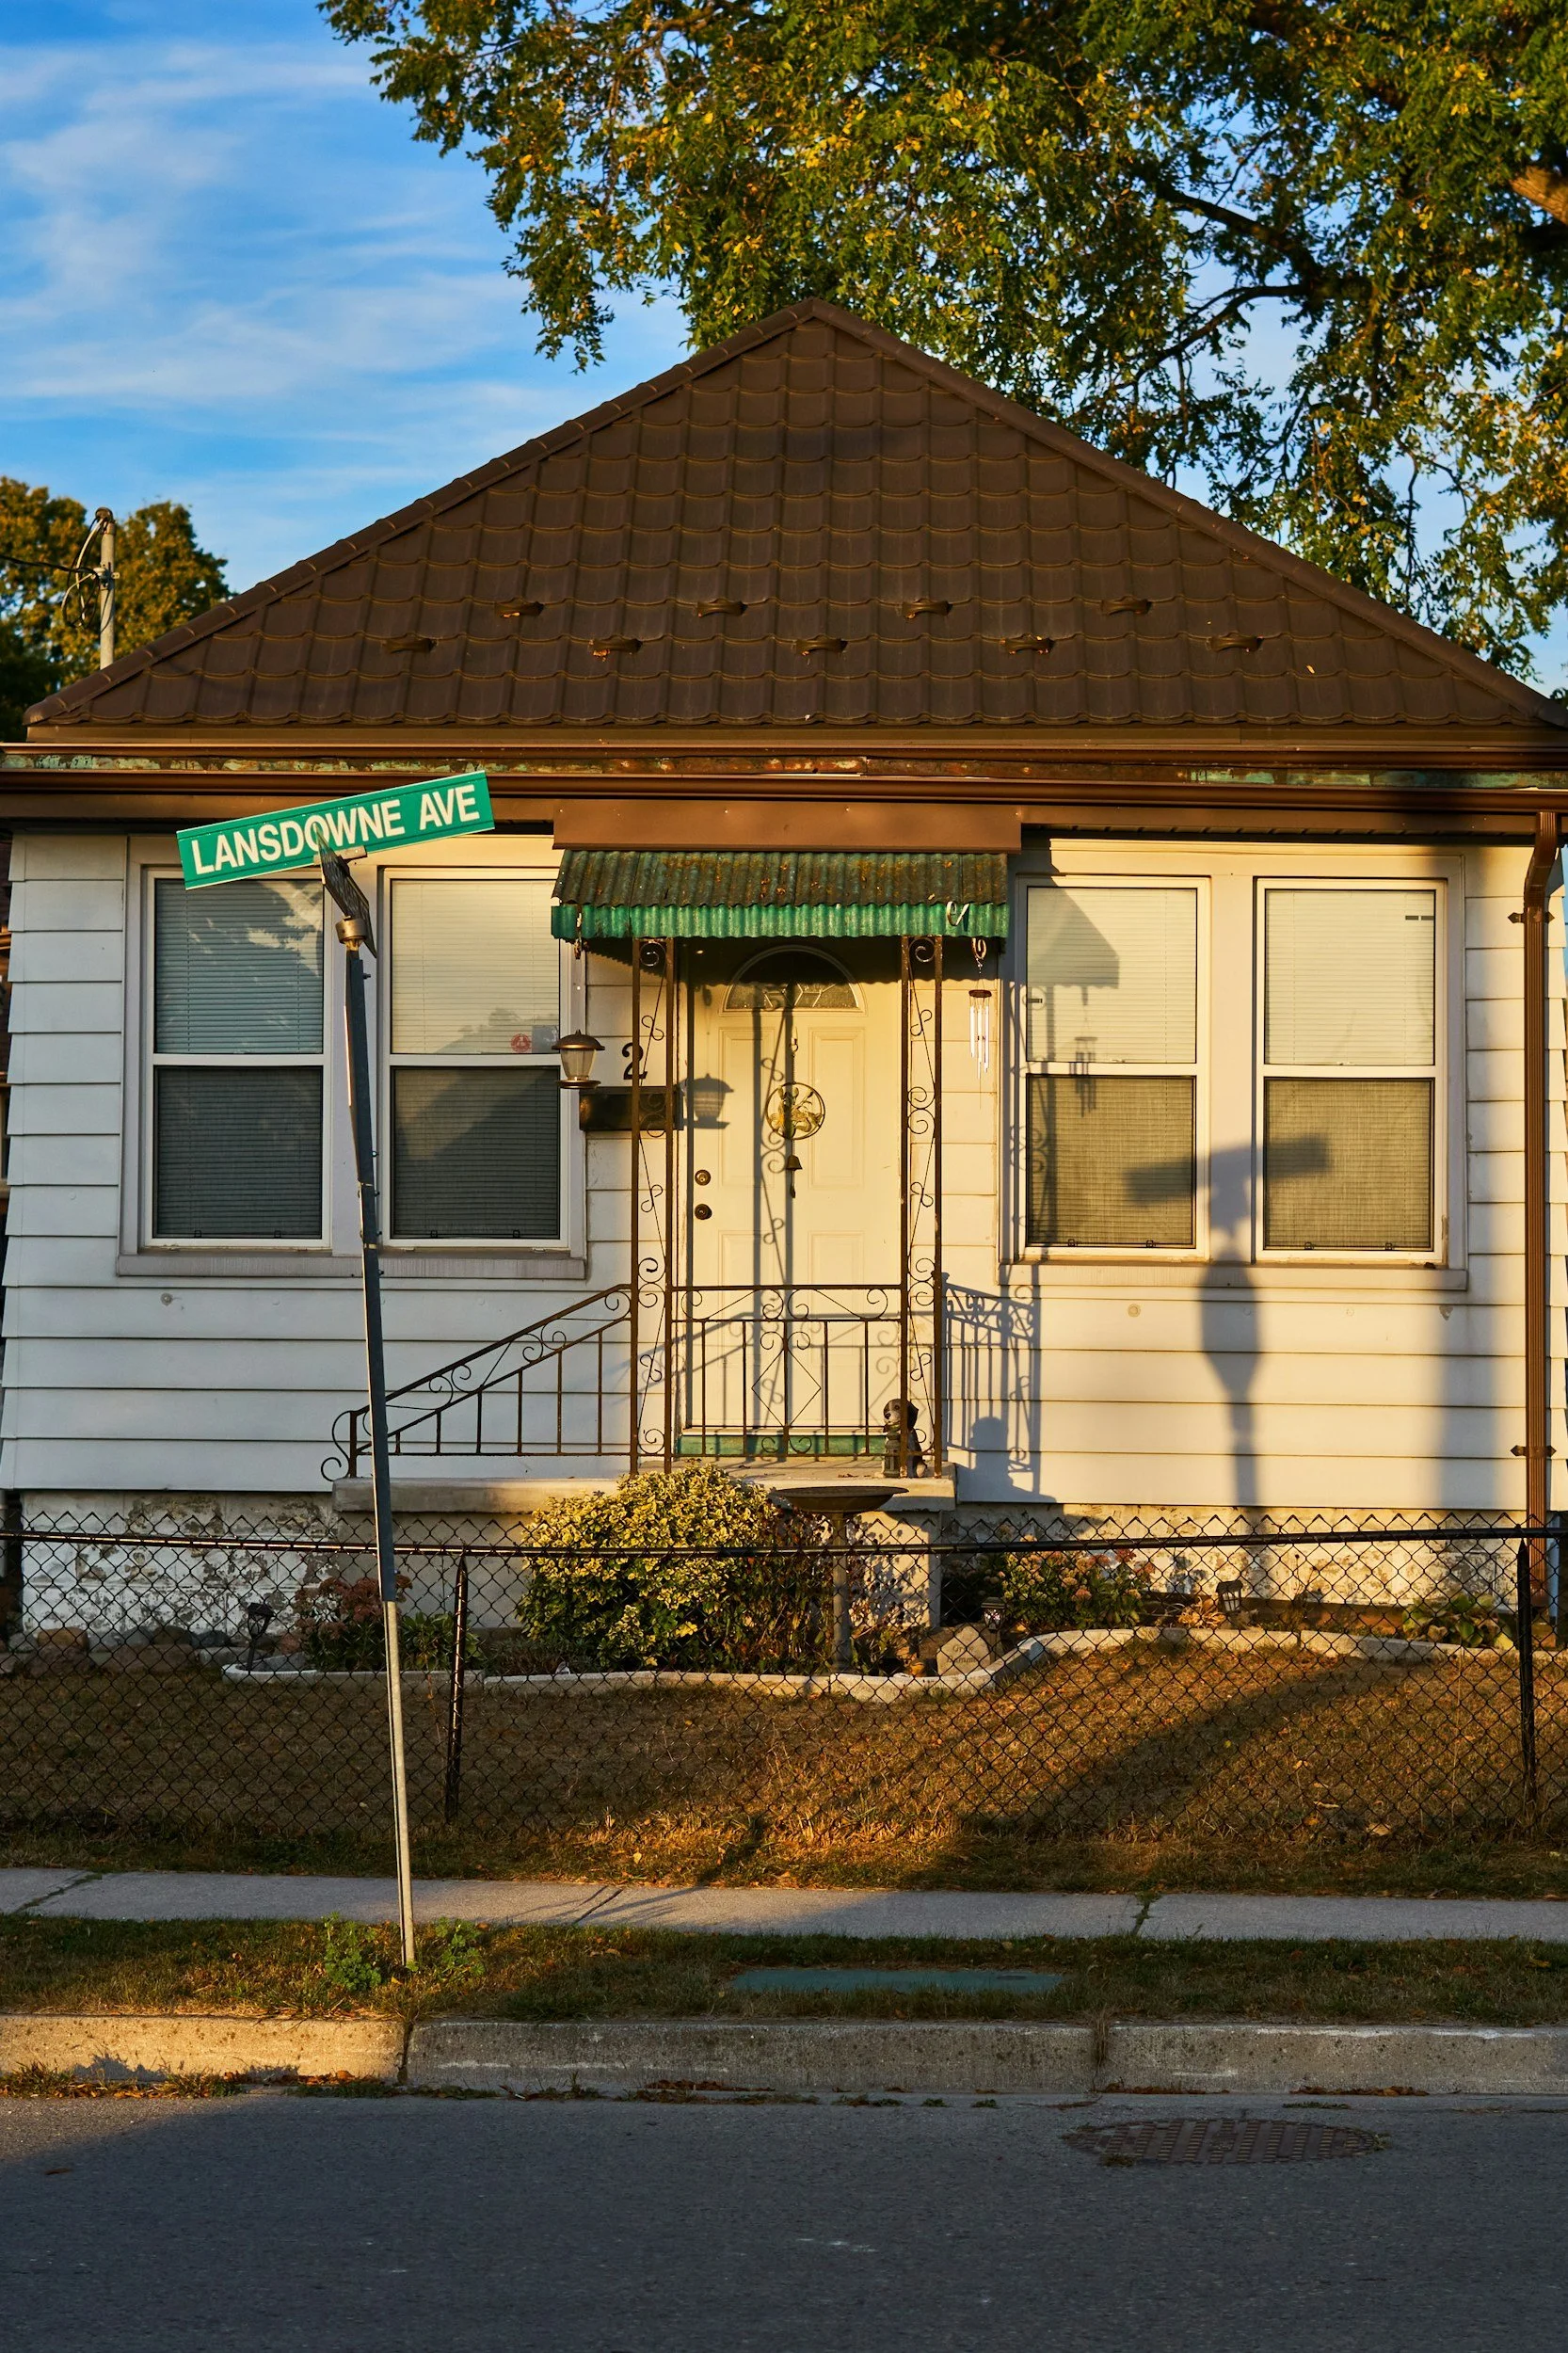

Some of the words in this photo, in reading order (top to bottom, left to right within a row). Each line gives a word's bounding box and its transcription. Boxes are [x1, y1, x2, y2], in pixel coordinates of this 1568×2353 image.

[191, 799, 406, 875] LANSDOWNE
[419, 784, 480, 831] AVE
[621, 1042, 648, 1080] 2
